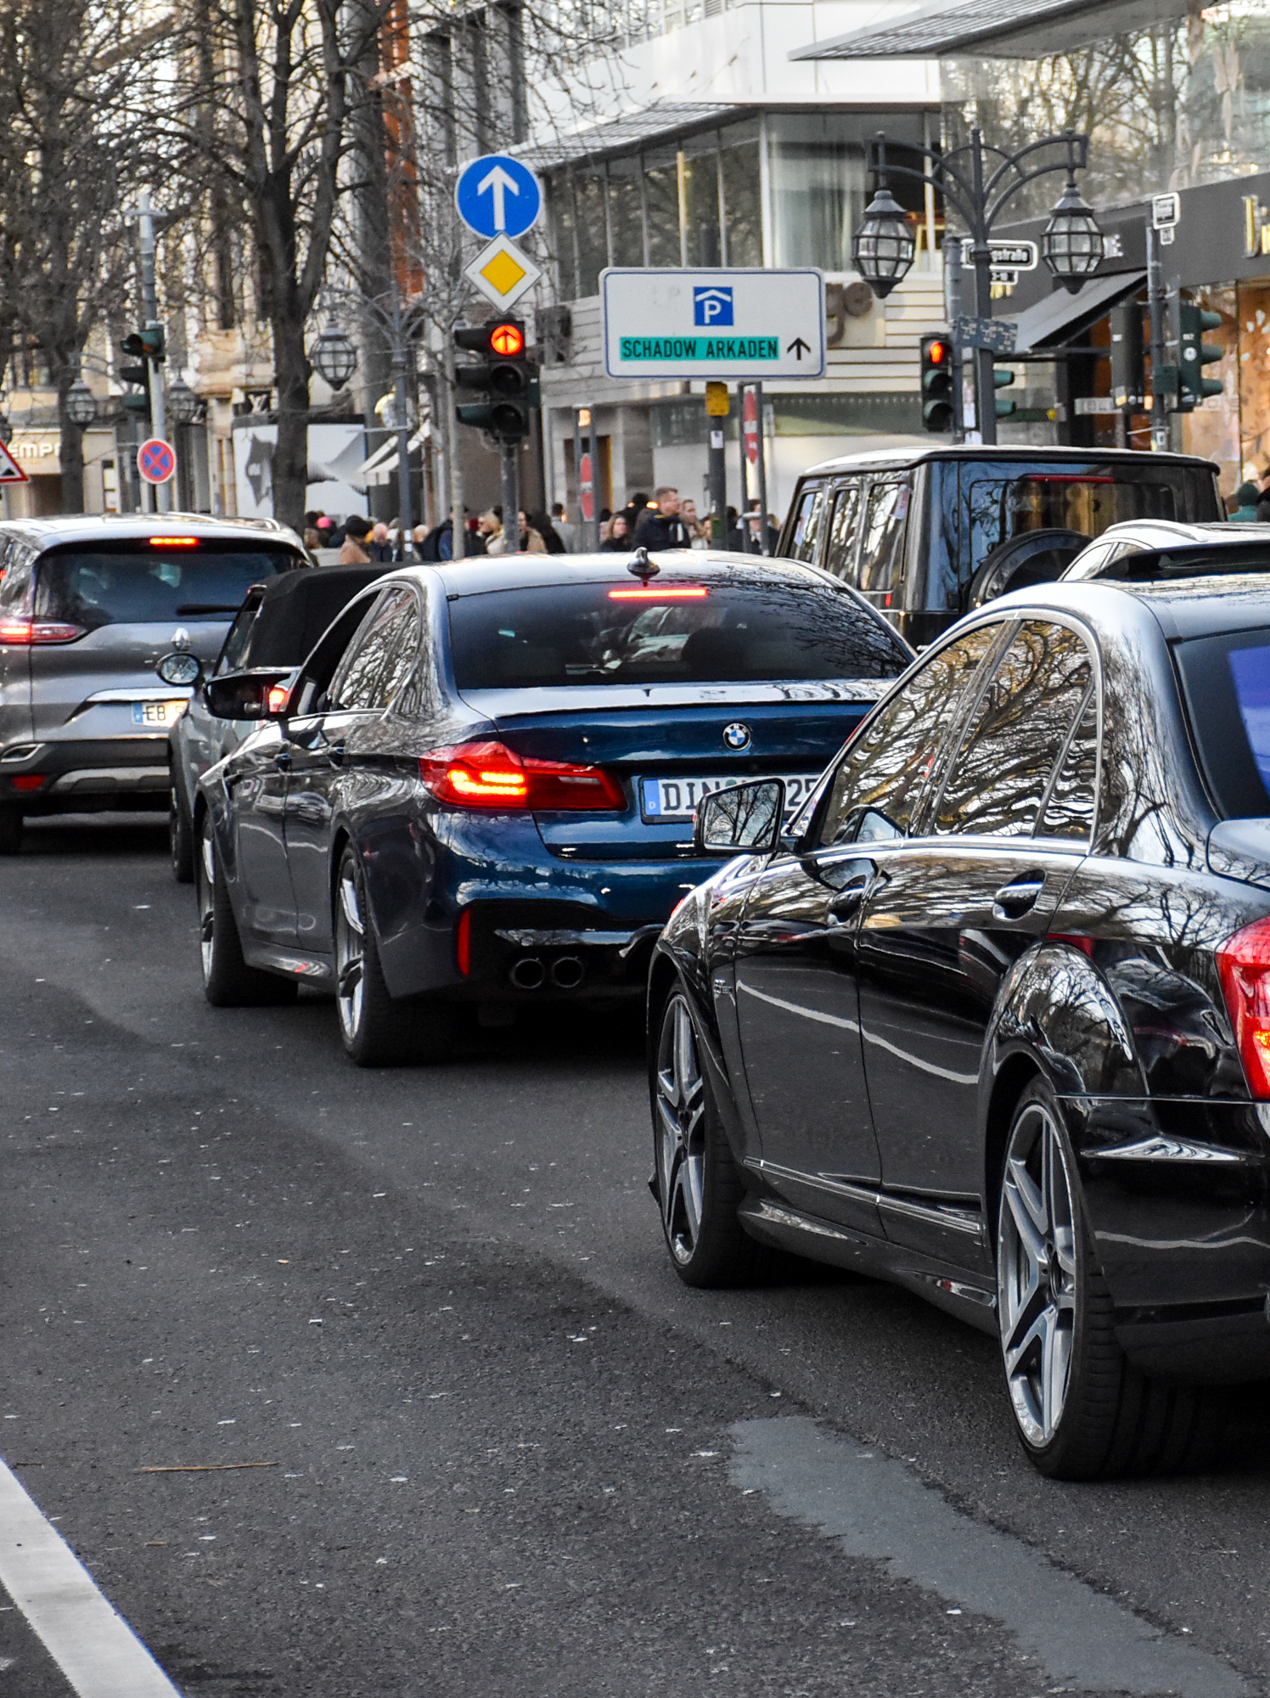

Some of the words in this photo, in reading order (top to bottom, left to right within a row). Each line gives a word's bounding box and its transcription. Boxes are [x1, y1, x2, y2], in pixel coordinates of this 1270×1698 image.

[702, 300, 721, 324] P
[622, 339, 697, 358] SCHADOW
[706, 339, 778, 358] ARKADEN
